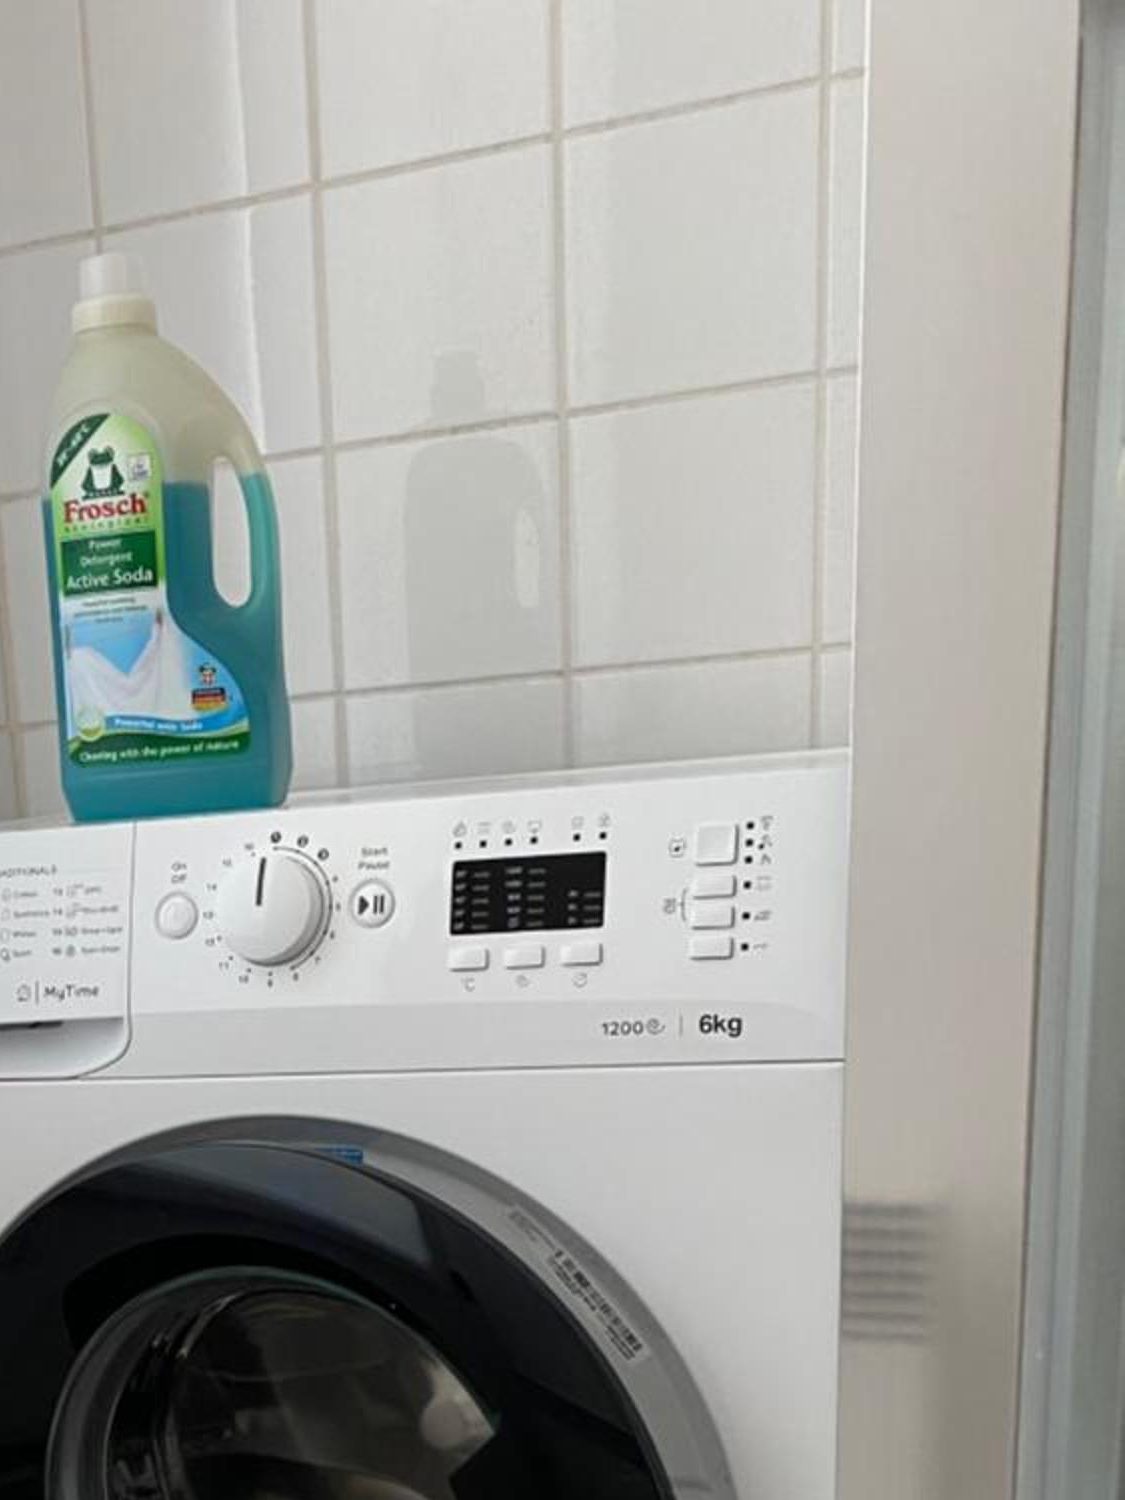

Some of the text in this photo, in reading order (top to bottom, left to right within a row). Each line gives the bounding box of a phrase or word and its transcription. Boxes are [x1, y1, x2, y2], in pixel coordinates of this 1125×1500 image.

[63, 493, 146, 523] Frosch
[66, 566, 154, 591] Active Soda
[602, 1013, 743, 1039] 1200 6kg
